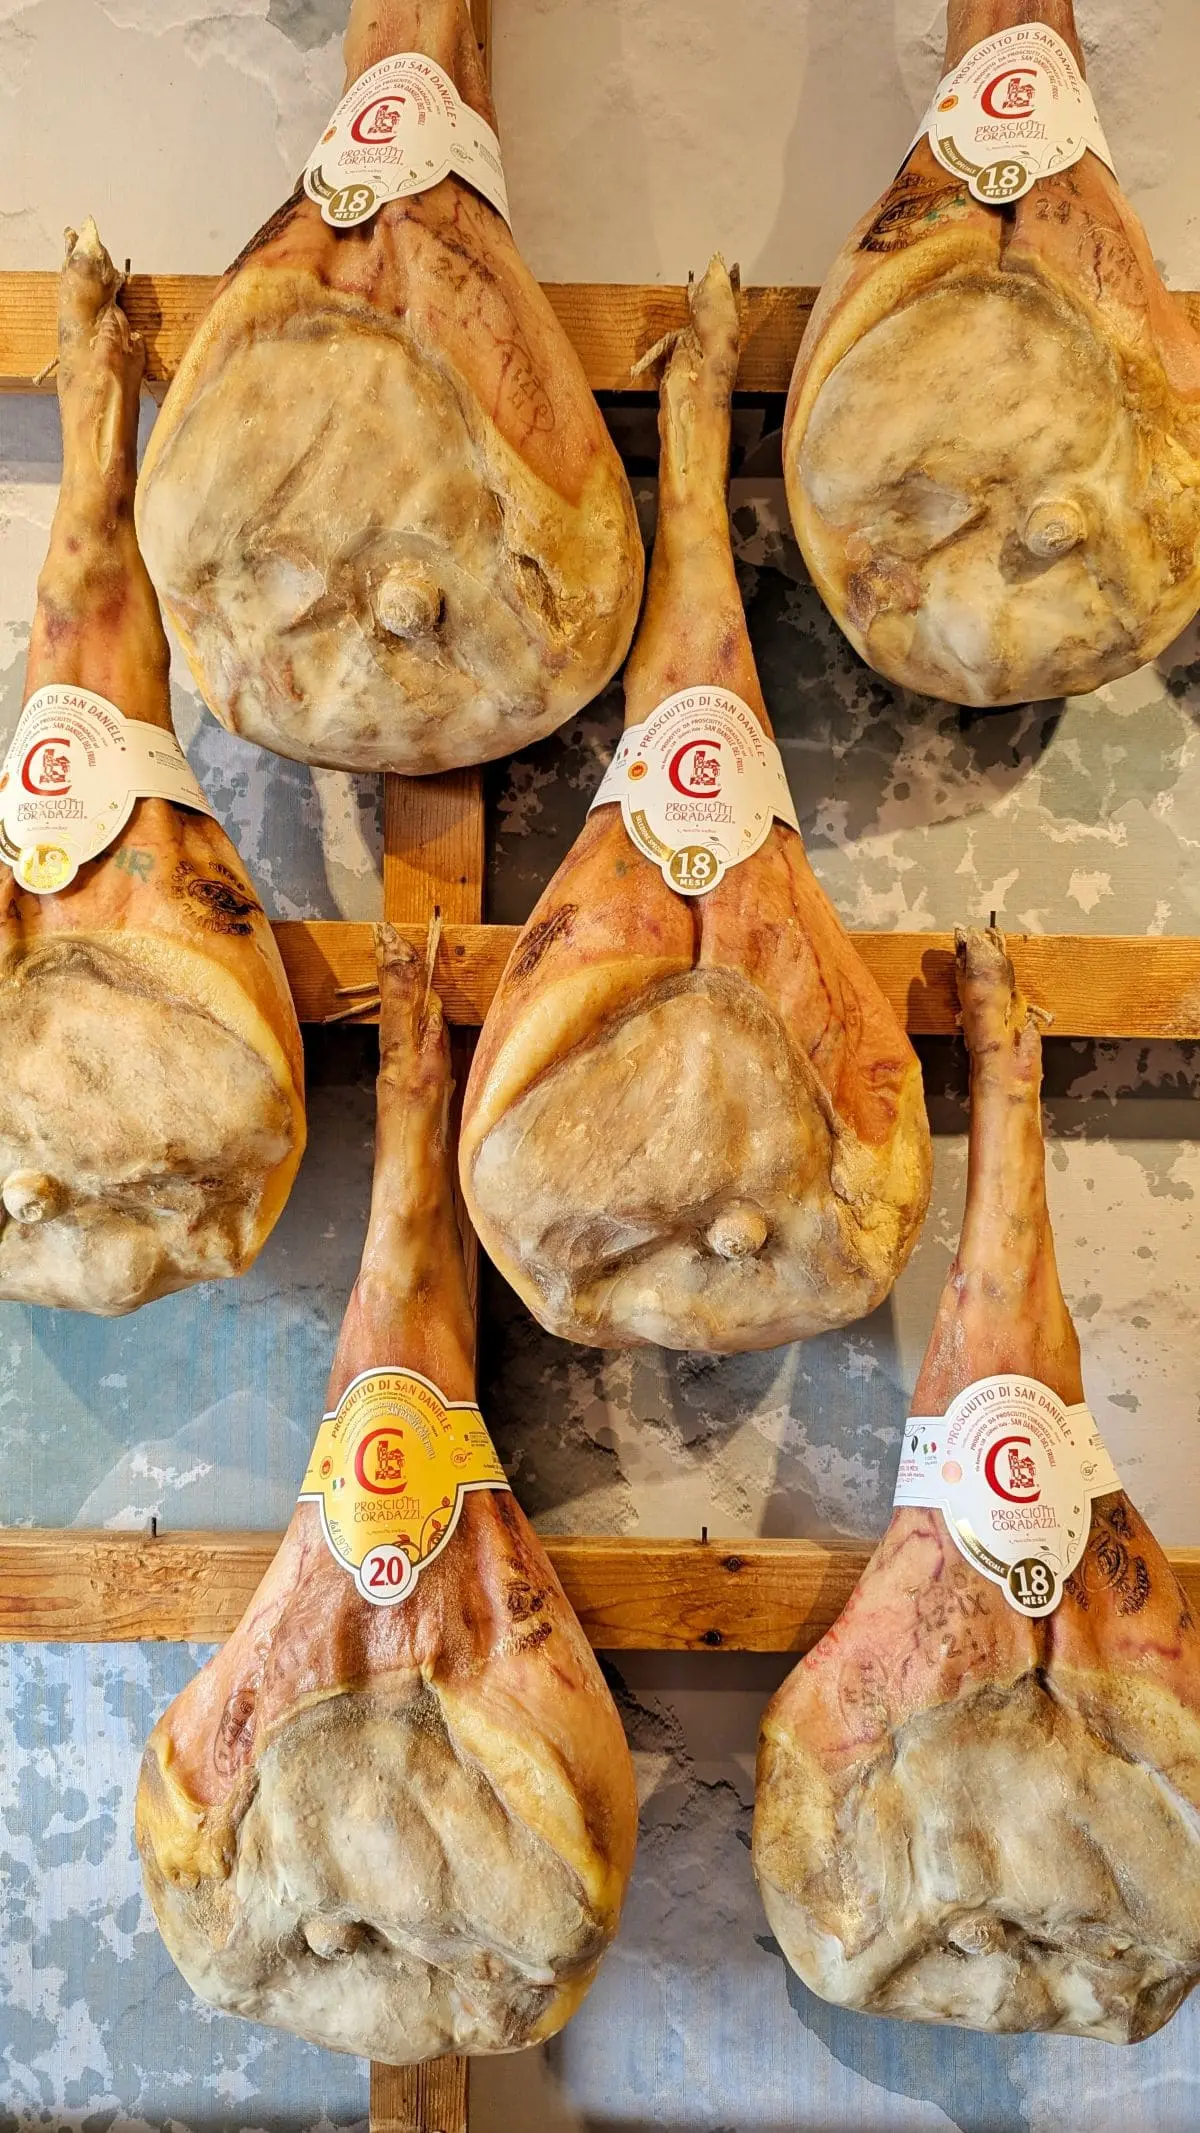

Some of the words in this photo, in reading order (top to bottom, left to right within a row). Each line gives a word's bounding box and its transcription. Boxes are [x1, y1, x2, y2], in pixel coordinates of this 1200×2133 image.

[952, 36, 1012, 85] PROSCIUTTO
[1017, 32, 1029, 41] DI
[1033, 32, 1055, 48] SAN
[1055, 48, 1080, 95] DANIELE
[337, 65, 391, 117] PROSCIUTTO
[394, 60, 406, 70] DI
[408, 61, 432, 76] SAN
[430, 75, 457, 120] DANIELE
[974, 130, 1045, 142] CORADAZZI
[337, 155, 402, 167] CORADAZZI
[983, 165, 1020, 190] 18
[334, 189, 370, 213] 18
[986, 188, 1013, 196] MESI
[47, 695, 58, 705] DI
[62, 695, 88, 710] SAN
[87, 705, 125, 744] DANIELE
[640, 698, 695, 749] PROSCIUTTO
[699, 696, 711, 705] DI
[714, 698, 738, 714] SAN
[736, 712, 765, 758] DANIELE
[17, 810, 84, 822] CORADAZZI
[665, 811, 733, 824] CORADAZZI
[676, 852, 711, 879] 18
[679, 878, 706, 886] MESI
[332, 1382, 375, 1439] PROSCIUTTO
[378, 1379, 390, 1390] DI
[394, 1380, 417, 1394] SAN
[418, 1391, 453, 1433] DANIELE
[947, 1389, 995, 1445] PROSCIUTTO
[999, 1386, 1010, 1397] DI
[1014, 1386, 1036, 1401] SAN
[1038, 1395, 1072, 1438] DANIELE
[353, 1510, 420, 1523] CORADAZZI
[992, 1518, 1057, 1531] CORADAZZI
[335, 1534, 353, 1556] 1976
[1014, 1564, 1050, 1596] 18
[1022, 1595, 1047, 1605] MESI
